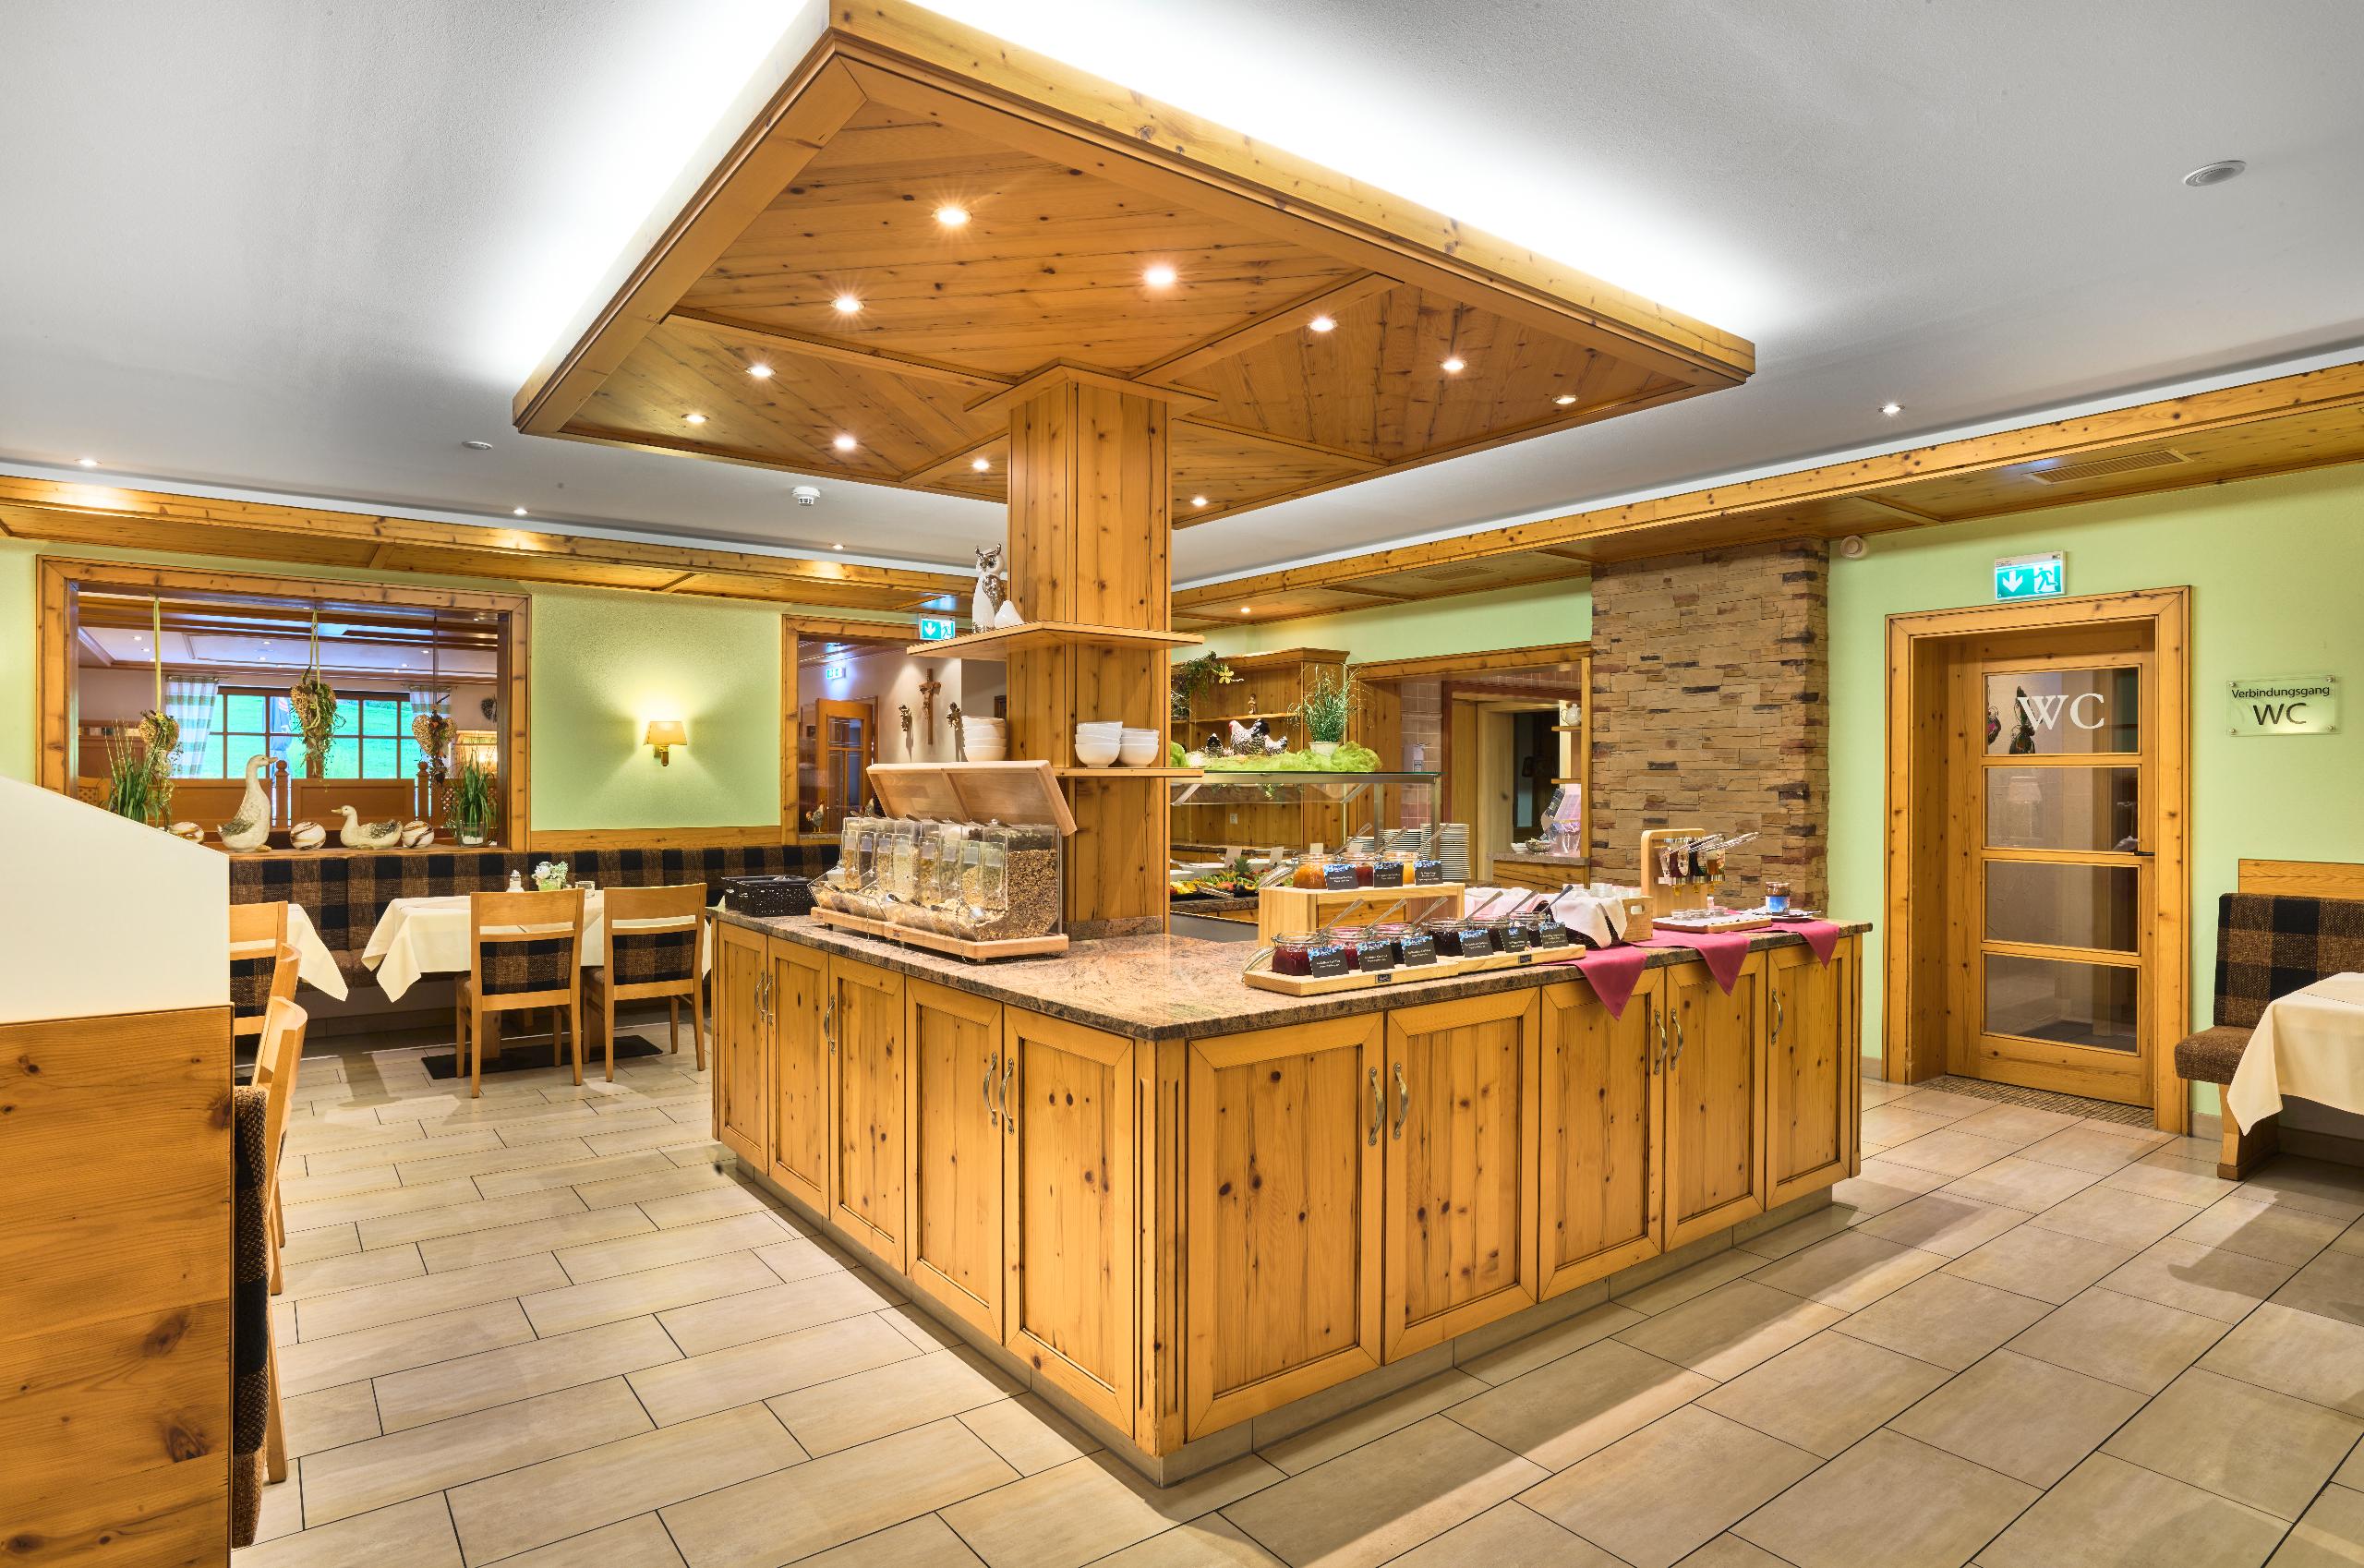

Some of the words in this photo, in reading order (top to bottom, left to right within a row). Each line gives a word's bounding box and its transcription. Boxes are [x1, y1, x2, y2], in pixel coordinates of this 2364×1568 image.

[2231, 686, 2330, 699] Verbindungsgang
[2017, 693, 2105, 730] WC
[2252, 702, 2307, 726] WC
